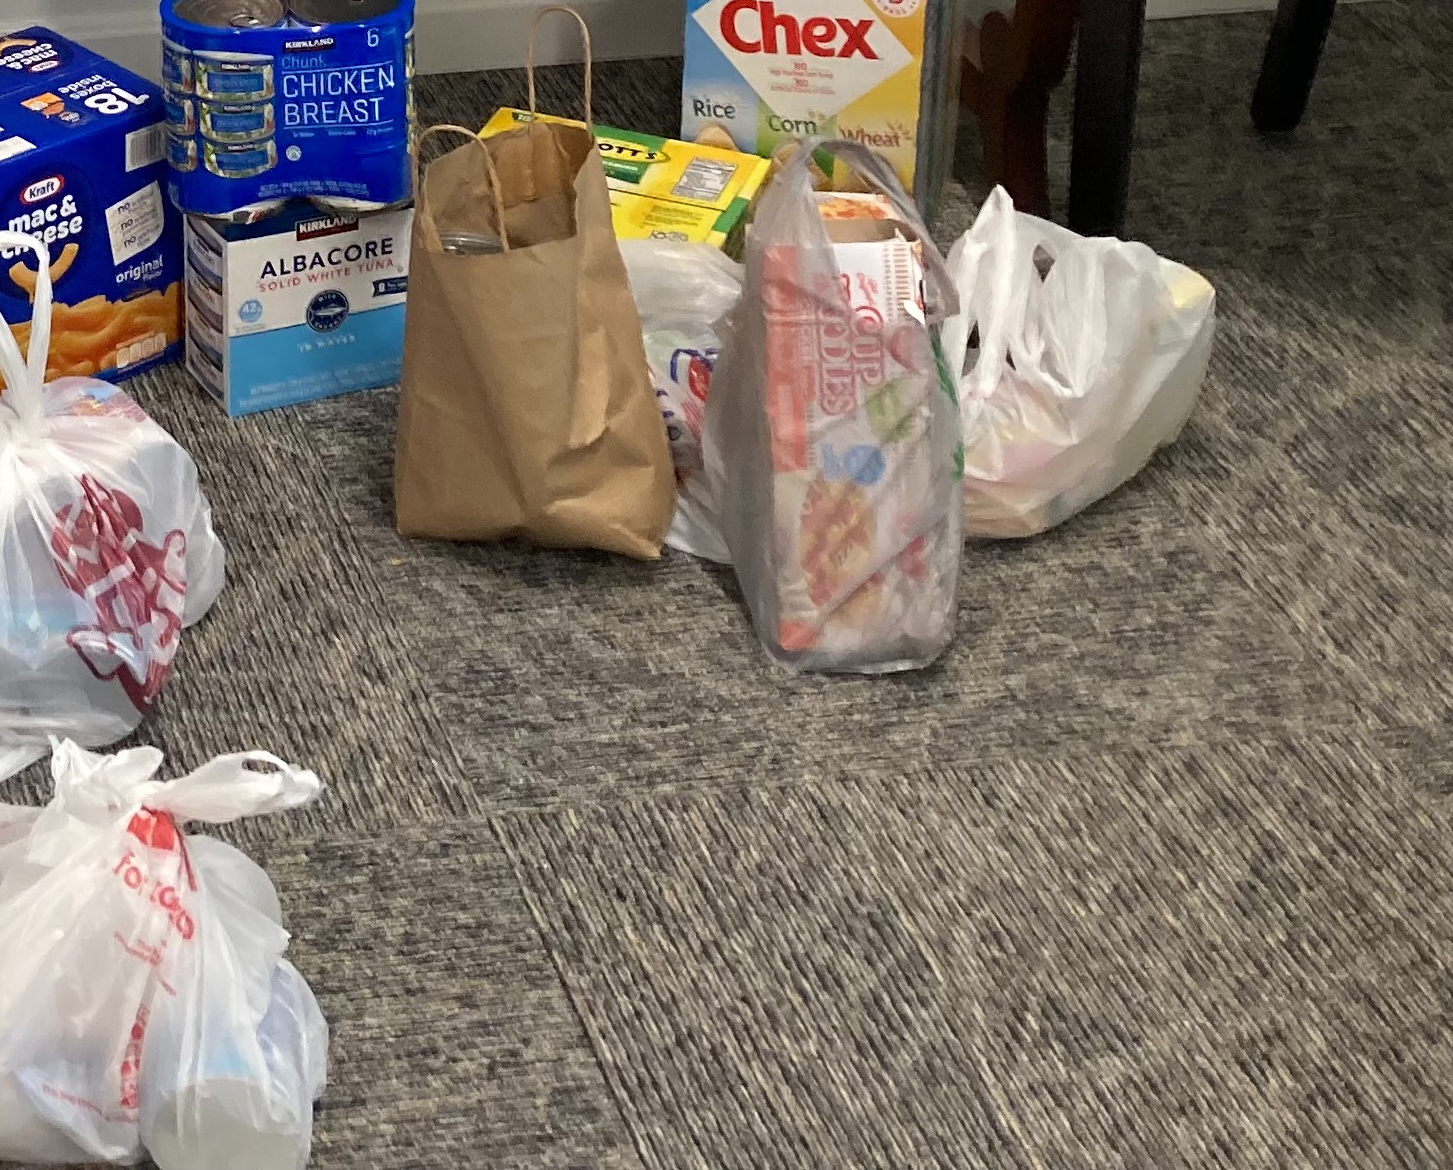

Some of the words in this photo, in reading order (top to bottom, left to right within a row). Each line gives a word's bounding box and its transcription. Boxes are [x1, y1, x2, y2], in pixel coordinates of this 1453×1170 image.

[285, 37, 335, 49] KIRKLAND
[367, 28, 379, 47] 6
[23, 49, 58, 65] mac
[281, 54, 326, 69] Chunk
[58, 74, 108, 94] inside
[69, 79, 119, 100] boxes
[282, 65, 395, 99] CHICKEN
[84, 87, 150, 114] 18
[693, 98, 736, 120] Rice
[283, 96, 385, 127] BREAST
[768, 114, 817, 134] Corn
[839, 123, 901, 148] Wheat
[598, 143, 658, 161] OTT'S
[29, 182, 55, 199] Kraft
[8, 205, 58, 234] mac
[60, 194, 77, 217] &
[117, 203, 131, 214] no
[120, 218, 134, 230] no
[299, 215, 357, 234] KIRKLAND
[124, 235, 137, 248] no
[115, 254, 164, 283] original
[260, 237, 393, 280] ALBACORE
[258, 276, 302, 294] SOLID
[307, 266, 352, 285] WHITE
[359, 258, 395, 274] TUNA
[852, 307, 885, 386] CUP
